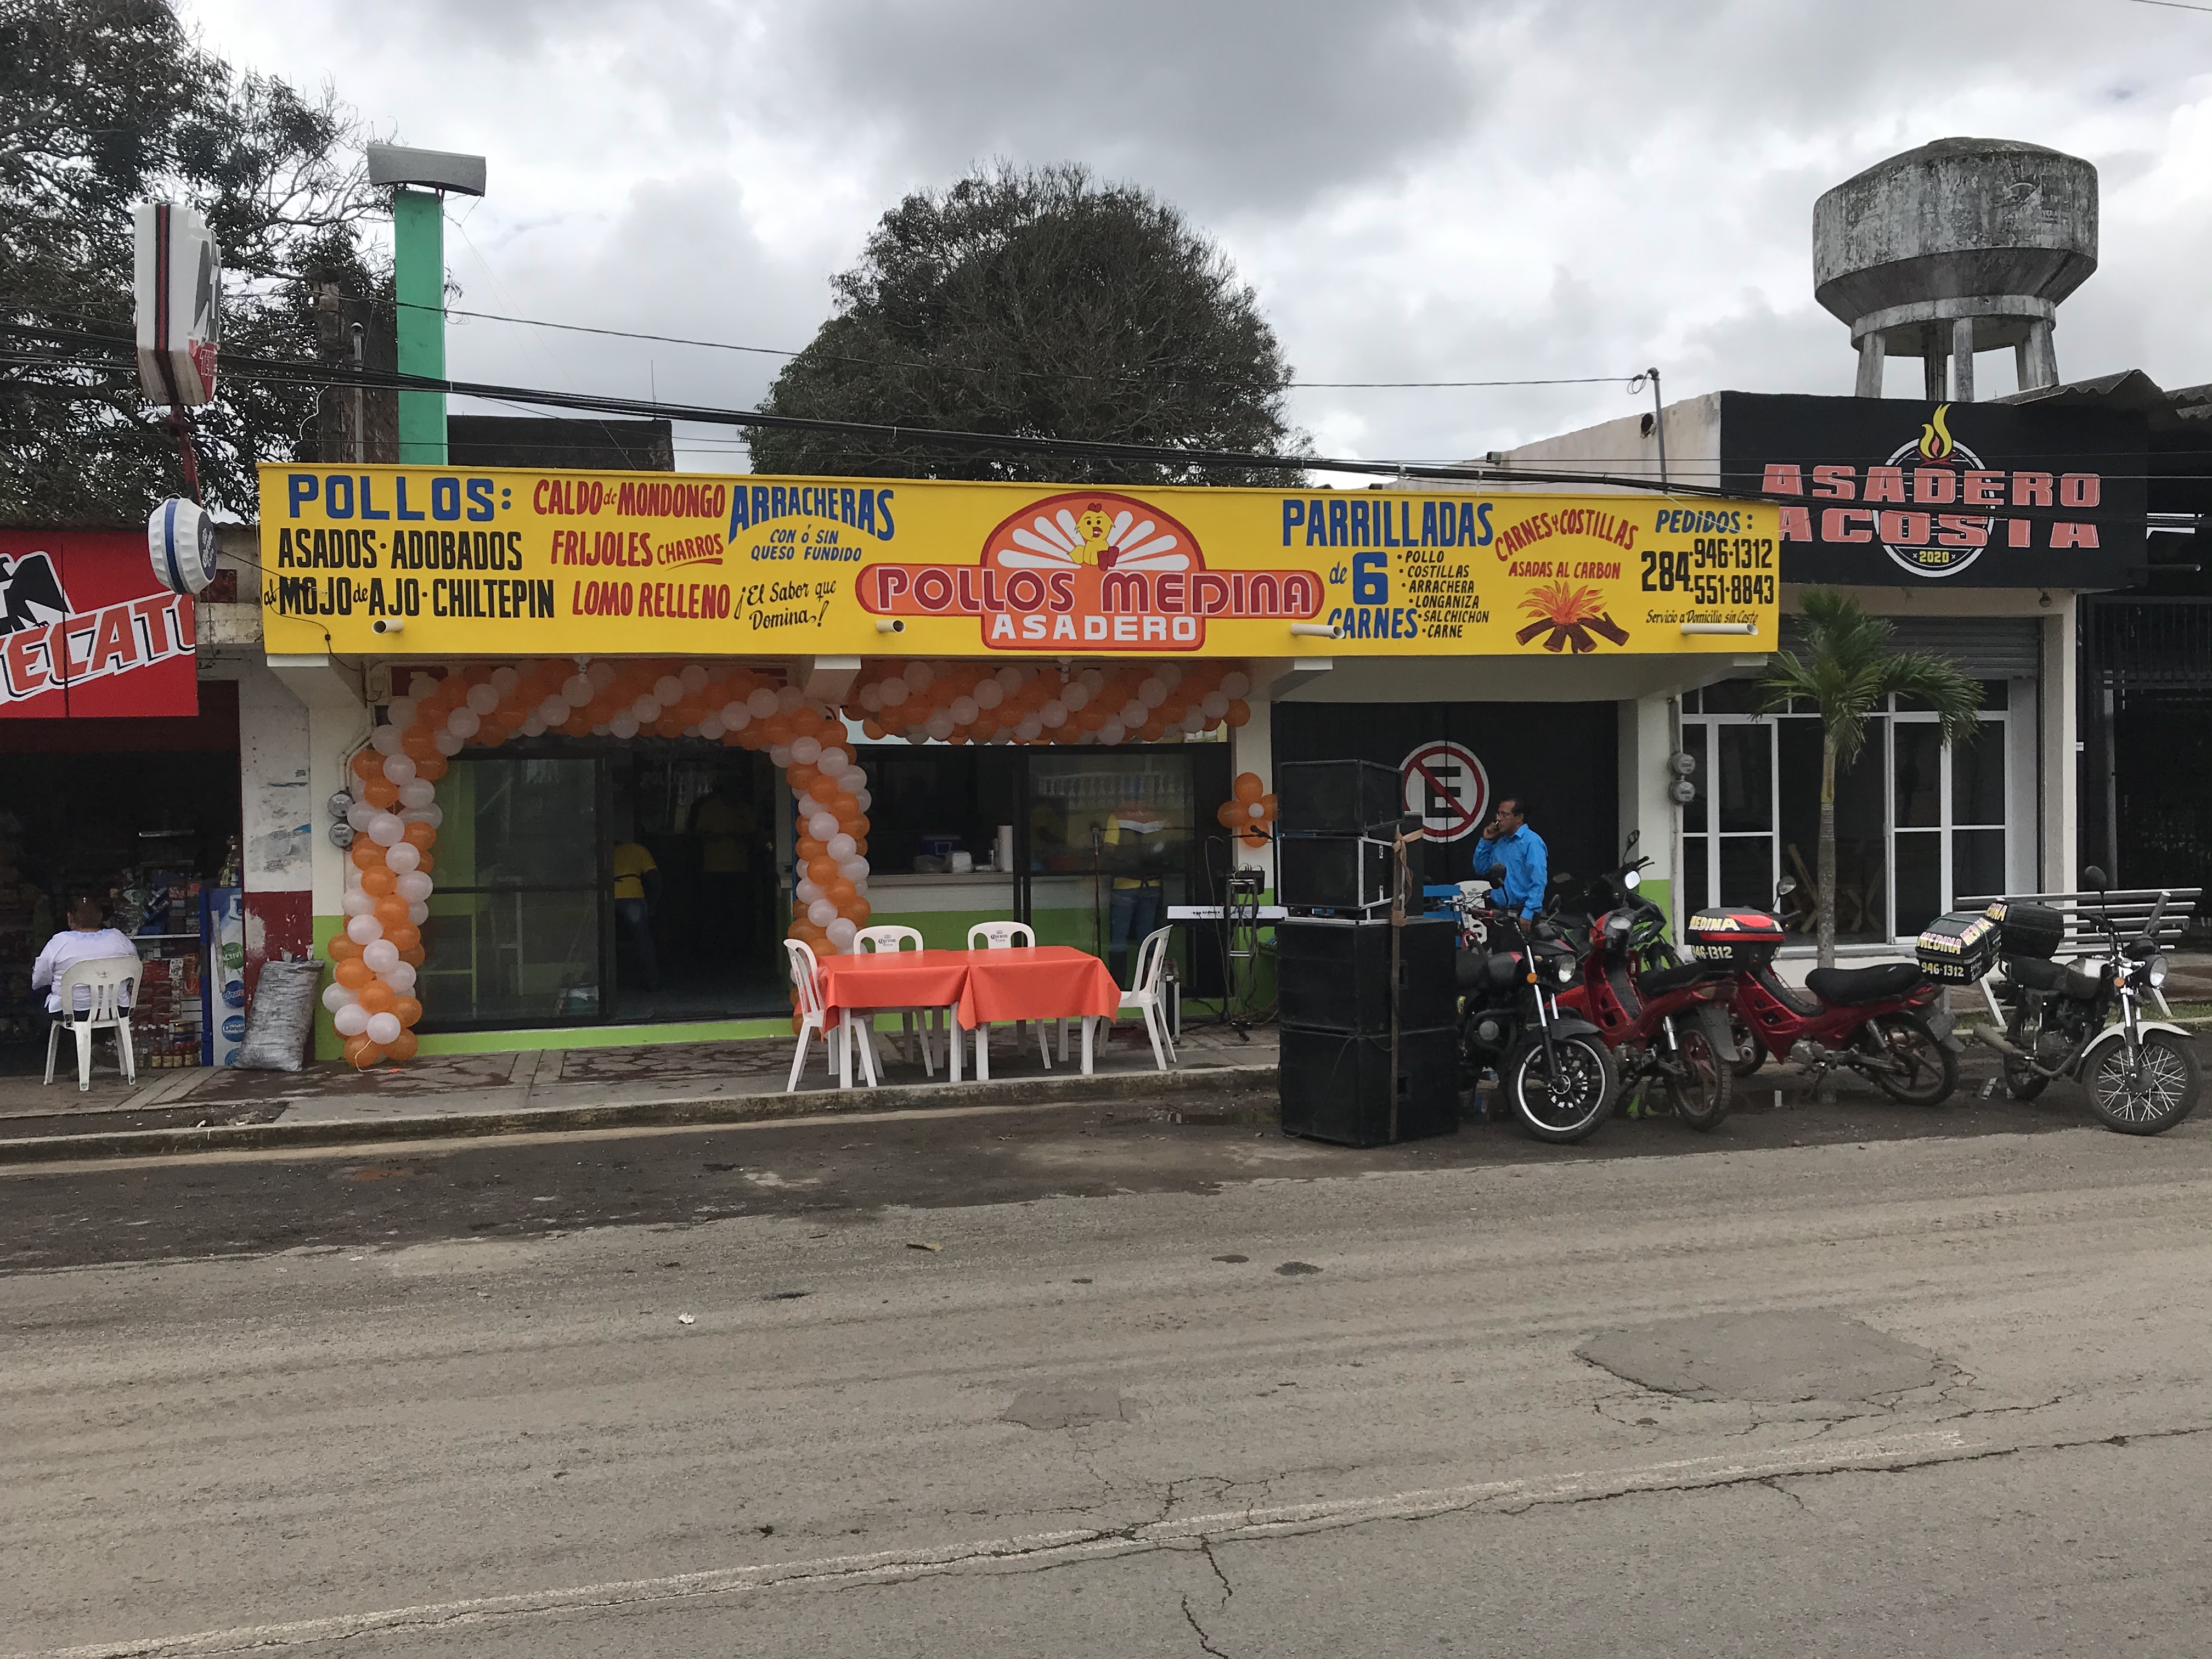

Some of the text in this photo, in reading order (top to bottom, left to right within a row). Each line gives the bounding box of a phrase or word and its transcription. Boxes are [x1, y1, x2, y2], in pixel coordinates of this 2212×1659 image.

[288, 475, 511, 522] POLLOS:
[534, 479, 725, 518] CALDO de MONDONGO
[1761, 463, 2101, 507] ASADERO
[729, 485, 895, 545] ARRACHERAS
[1283, 499, 1493, 548] PARRILLADAS
[278, 528, 522, 571] ASADOS ADOBADOS
[551, 530, 724, 567] FRIJOLES CHARROS
[770, 529, 797, 544] CON
[815, 529, 839, 544] SIN
[1495, 512, 1553, 561] CARNES
[1560, 509, 1639, 550] COSTILLAS
[751, 545, 862, 562] QUESO FUNDIDO
[1405, 550, 1444, 563] POLLO
[1919, 551, 1949, 563] 2020
[1329, 551, 1389, 605] de 6
[1407, 565, 1470, 578] COSTILLAS
[1508, 561, 1621, 580] ASADAS AL CARBON
[1641, 550, 1690, 591] 284
[263, 578, 277, 605] al
[279, 577, 352, 616] MOJO
[353, 582, 368, 603] de
[433, 578, 555, 618] CHILTEPIN
[572, 580, 731, 619] LOMO RELLENO
[769, 581, 809, 603] Sabor
[815, 580, 837, 602] que
[877, 567, 1313, 615] POLLOS MEDINA
[1409, 580, 1474, 594] ARRACHERA
[1415, 595, 1480, 609] LONGANIZA
[1423, 610, 1489, 623] SALCHICHON
[1646, 609, 1759, 624] Servicio a Domicilio sin Costo
[992, 614, 1196, 641] ASADERO
[1327, 607, 1418, 639] CARNES
[1427, 624, 1463, 639] CARNE
[1425, 766, 1462, 817] E
[1917, 932, 1962, 955] MEDINA
[1921, 962, 1964, 977] 946-1312
